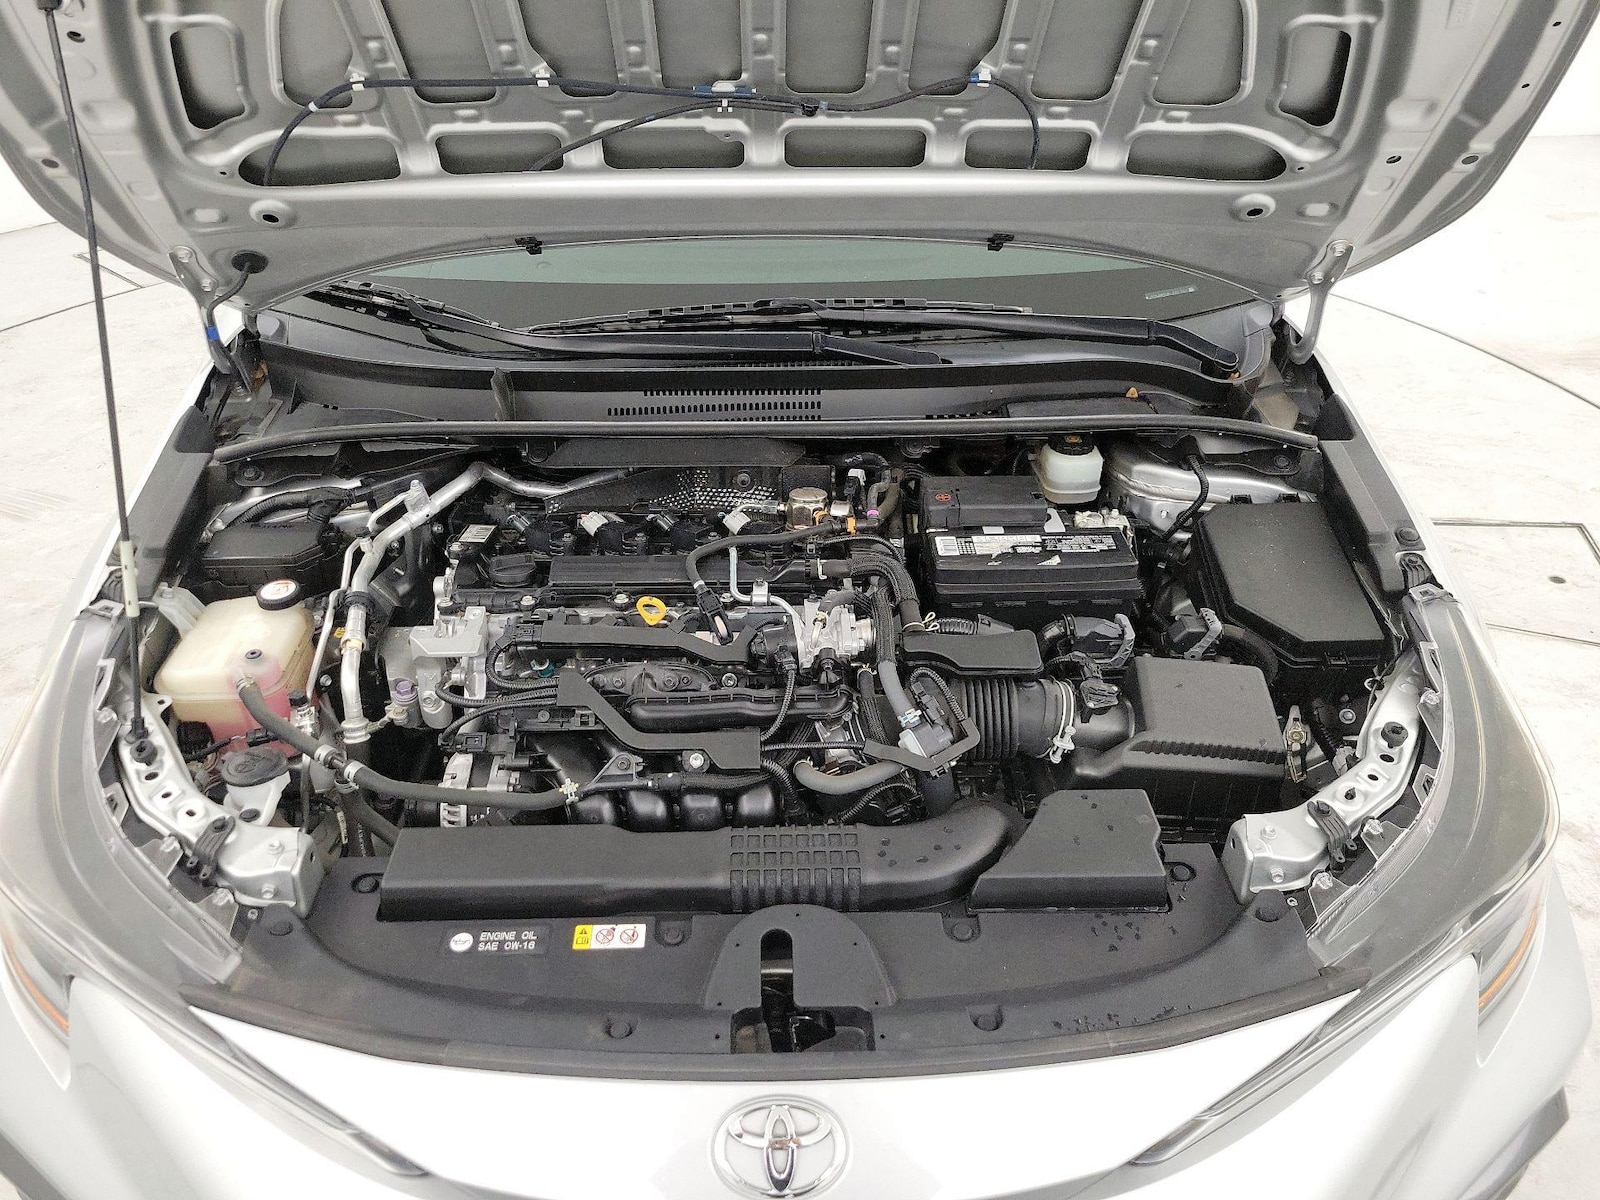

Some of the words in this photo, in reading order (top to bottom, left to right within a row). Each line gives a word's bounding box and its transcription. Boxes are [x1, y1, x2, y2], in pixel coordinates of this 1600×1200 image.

[480, 931, 516, 940] ENGINE
[521, 931, 538, 940] OIL
[478, 941, 499, 951] SAE
[504, 941, 536, 950] 0W-16
